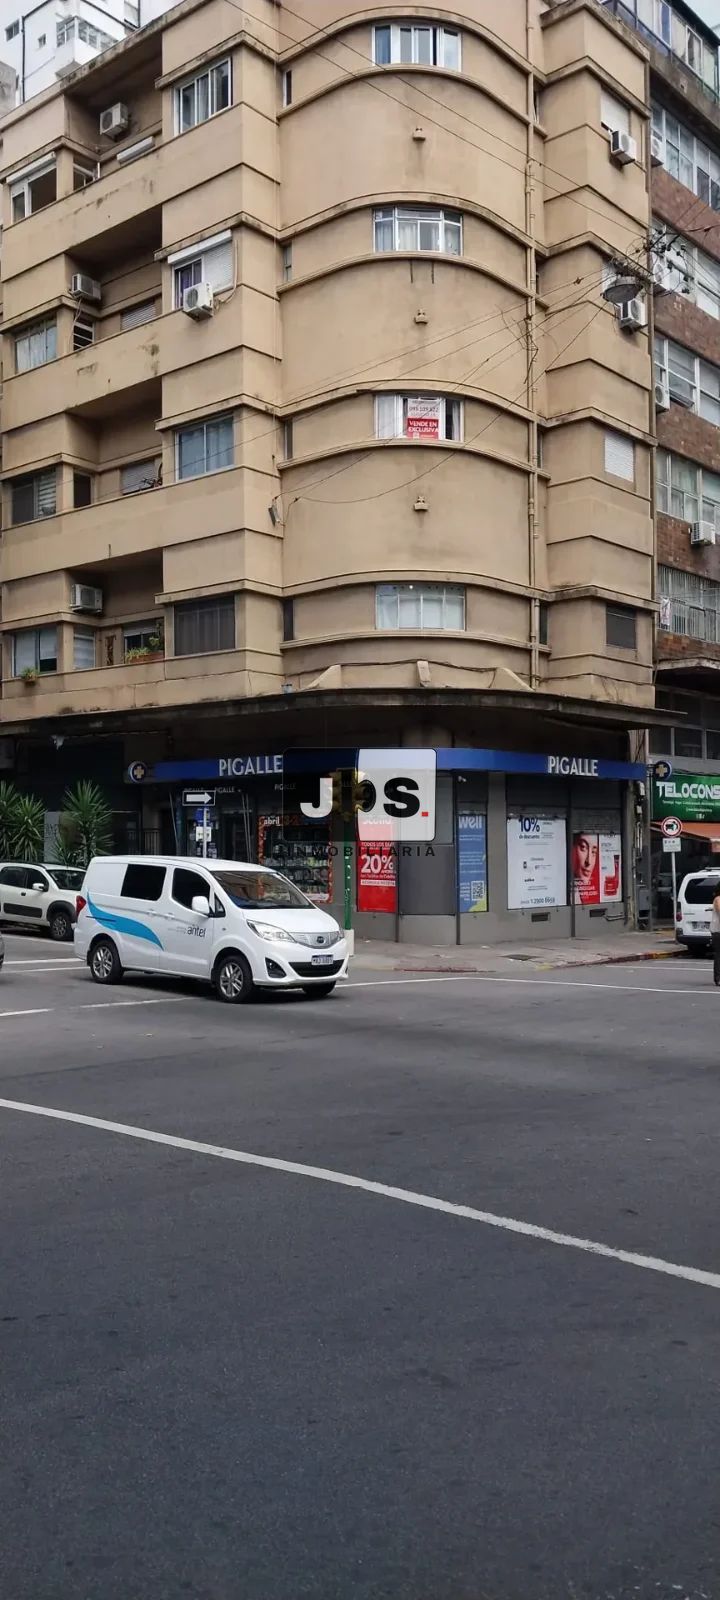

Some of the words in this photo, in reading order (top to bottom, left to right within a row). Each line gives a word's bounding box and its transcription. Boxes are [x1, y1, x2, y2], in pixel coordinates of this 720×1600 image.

[219, 755, 283, 776] PIGALLE
[547, 756, 599, 777] PIGALLE
[519, 815, 541, 832] 10%
[361, 854, 394, 874] 20%
[188, 924, 206, 938] antel
